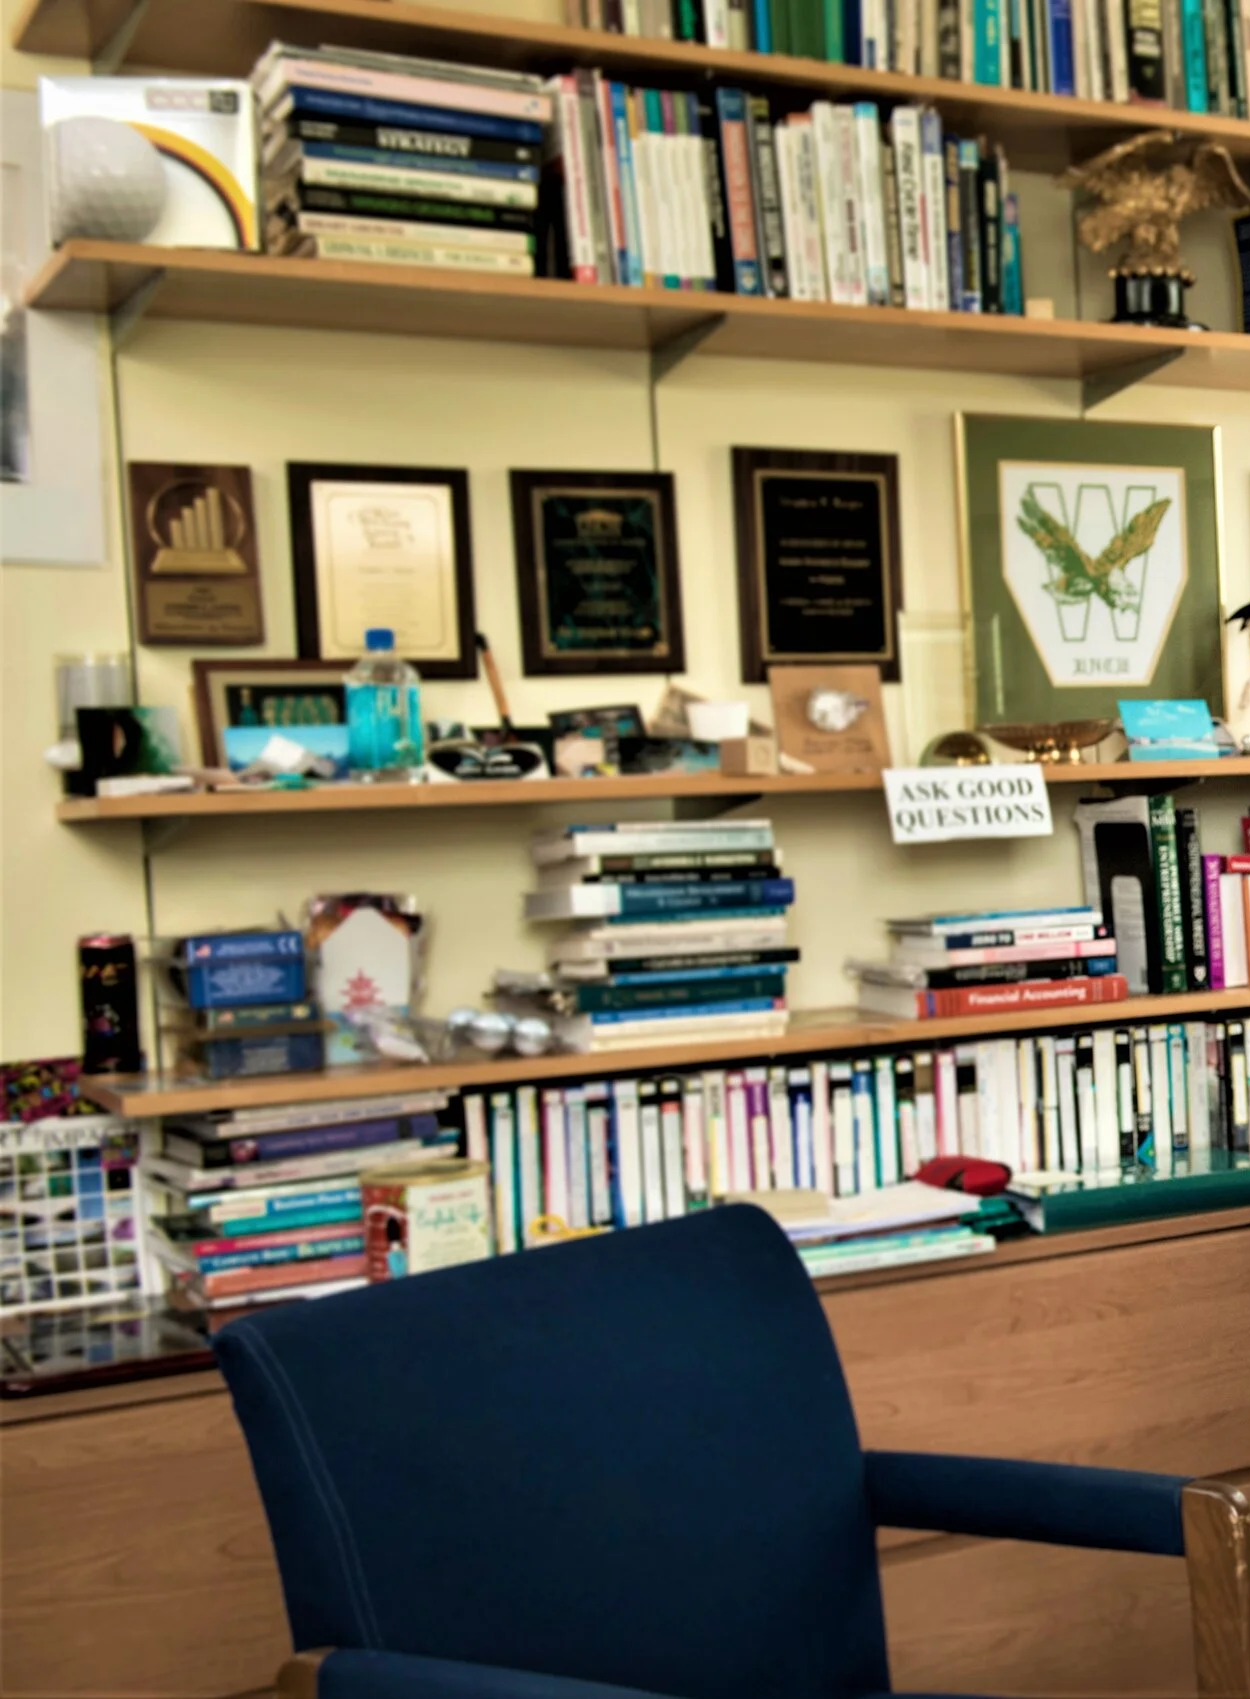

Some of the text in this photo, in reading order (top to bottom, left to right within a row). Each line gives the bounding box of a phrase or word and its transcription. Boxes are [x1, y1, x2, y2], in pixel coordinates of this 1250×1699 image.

[377, 127, 471, 157] STRATEGY
[899, 777, 1034, 801] ASK GOOD
[896, 804, 1044, 832] QUESTIONS
[278, 937, 298, 953] CE
[1037, 930, 1073, 941] MILLION
[968, 984, 1088, 1006] Financial Accounting
